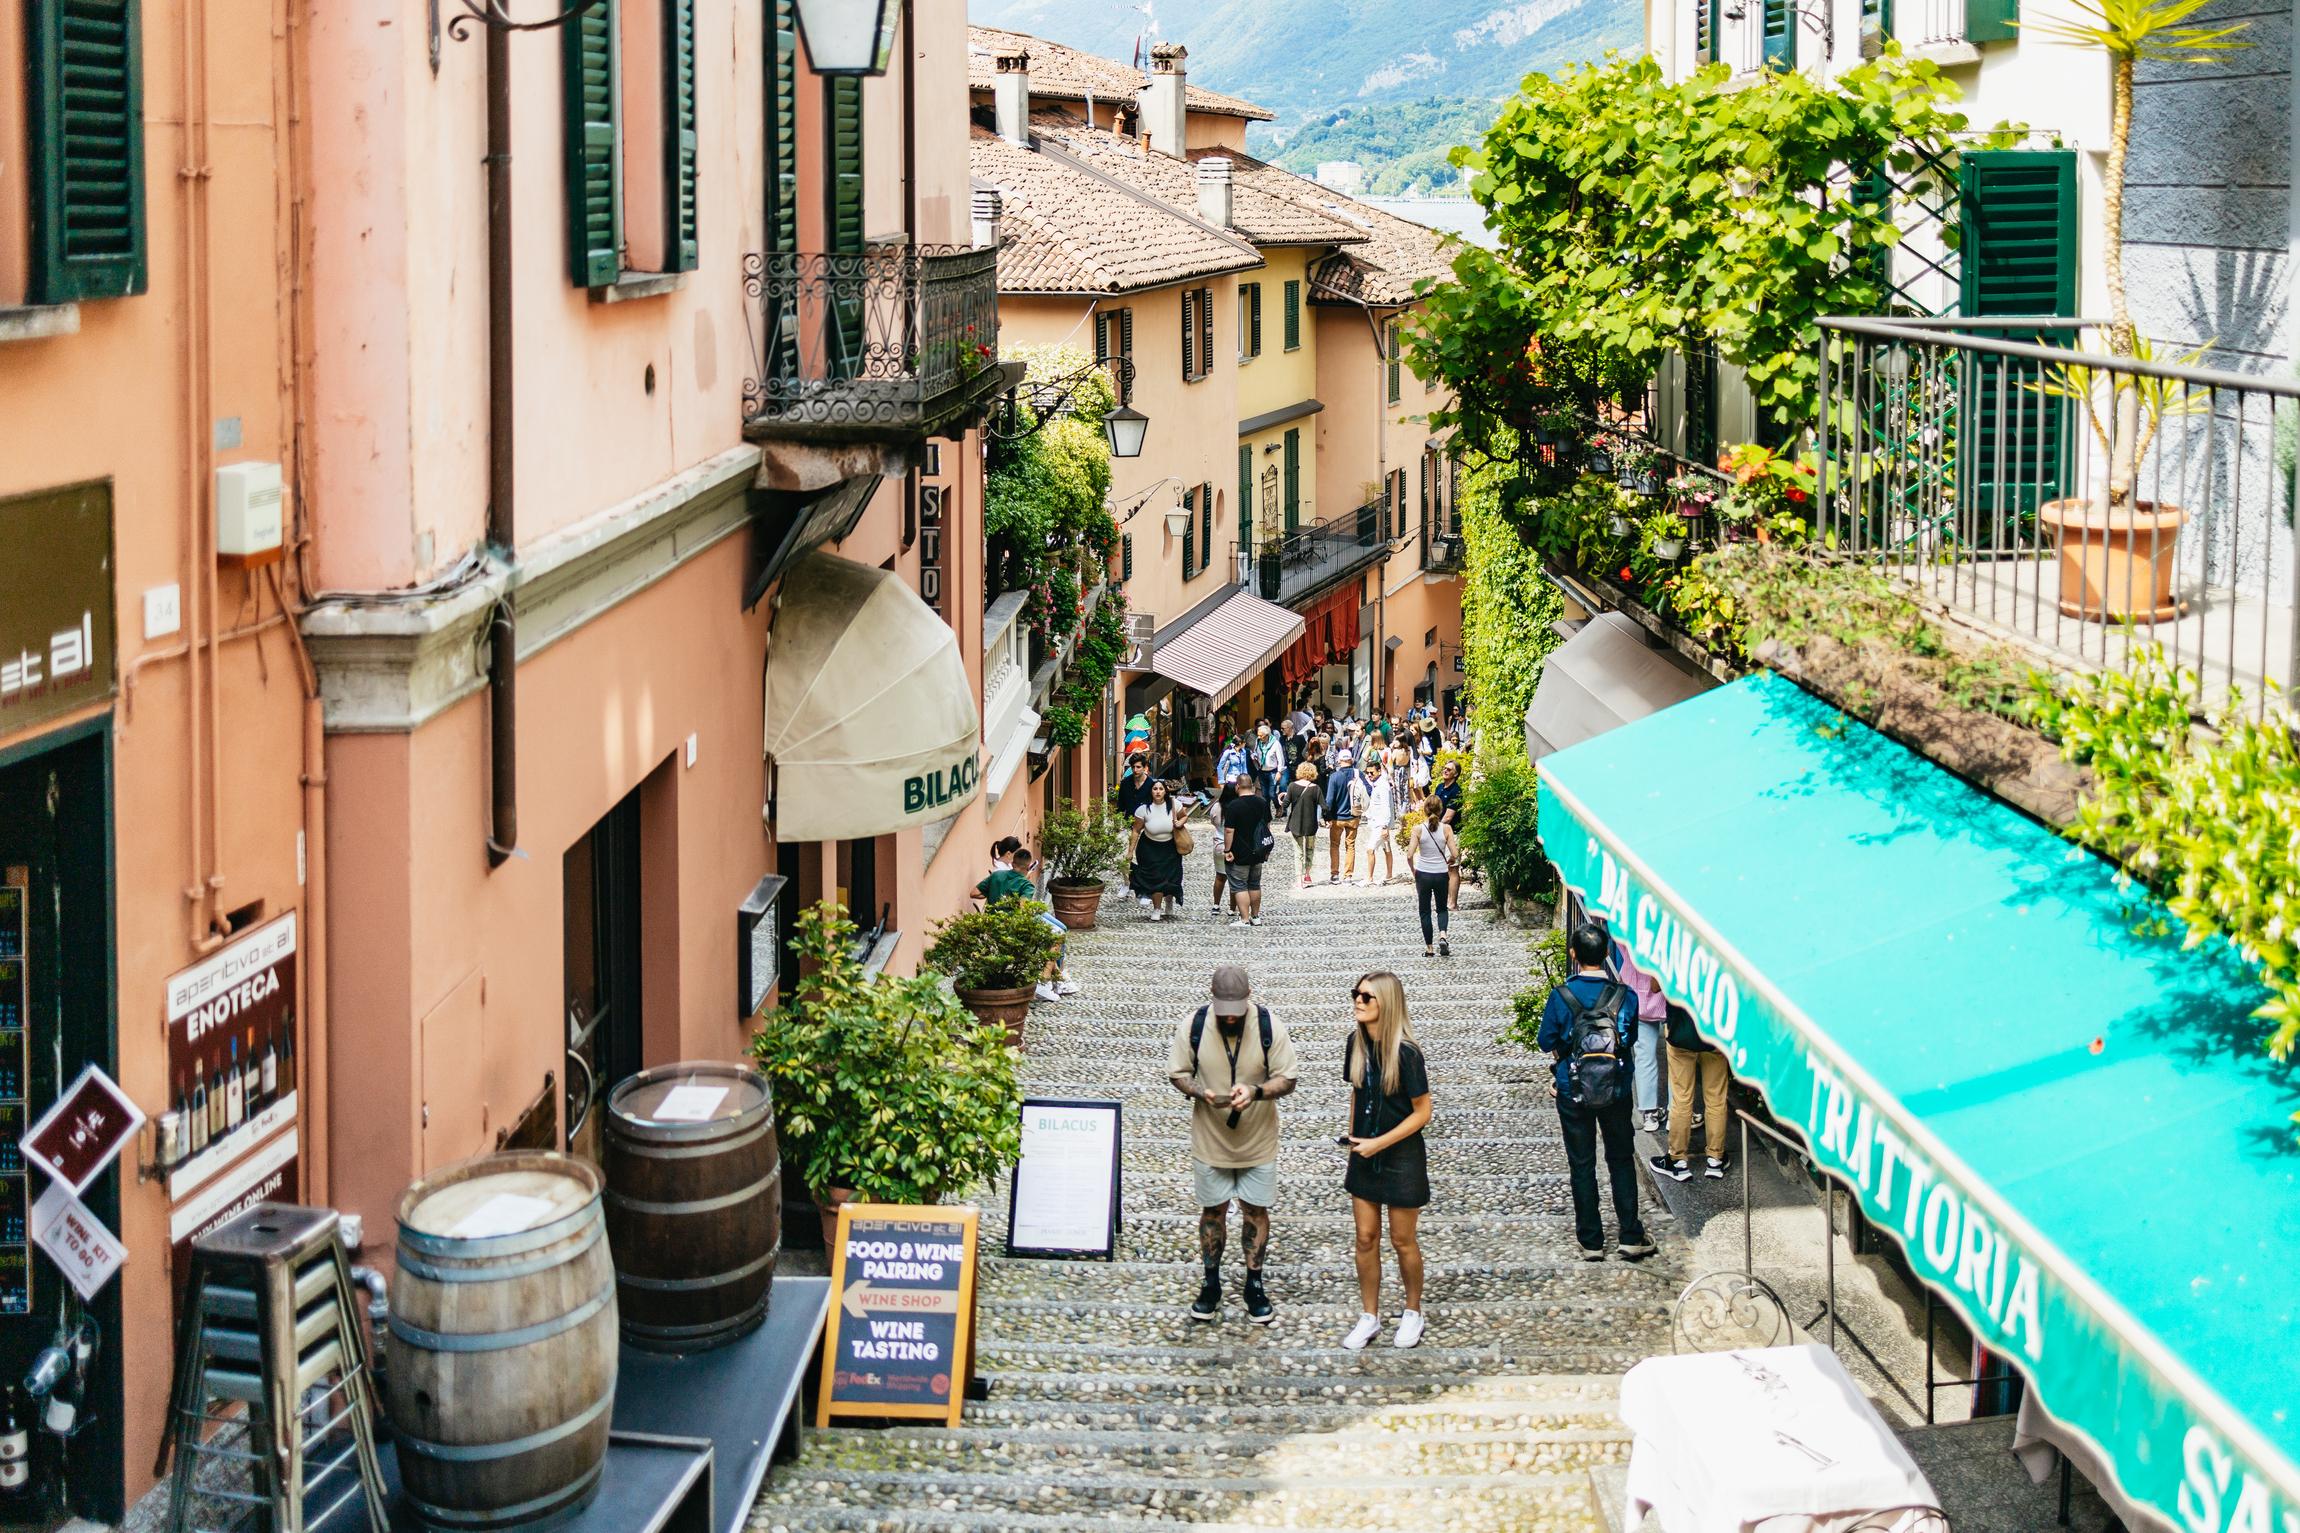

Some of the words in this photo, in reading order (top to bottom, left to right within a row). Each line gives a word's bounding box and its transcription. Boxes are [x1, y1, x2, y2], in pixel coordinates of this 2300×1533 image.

[922, 446, 938, 599] ISTO
[1, 646, 42, 692] et
[51, 609, 92, 677] al
[176, 947, 260, 1006] aperitivo
[187, 965, 280, 1043] ENOTECA
[1038, 1118, 1097, 1132] BILACUS
[244, 1173, 282, 1208] ONLINE
[1806, 1050, 2042, 1362] TRATTORIA
[65, 1213, 92, 1245] WINE
[92, 1243, 112, 1264] KIT
[65, 1232, 79, 1251] TO
[846, 1240, 898, 1259] FOOD
[900, 1242, 913, 1260] &
[914, 1243, 964, 1262] WINE
[863, 1261, 944, 1281] PAIRING
[859, 1294, 897, 1306] WINE
[901, 1296, 941, 1308] SHOP
[870, 1320, 924, 1340] WINE
[851, 1340, 939, 1361] TASTING
[2177, 1425, 2300, 1533] SA
